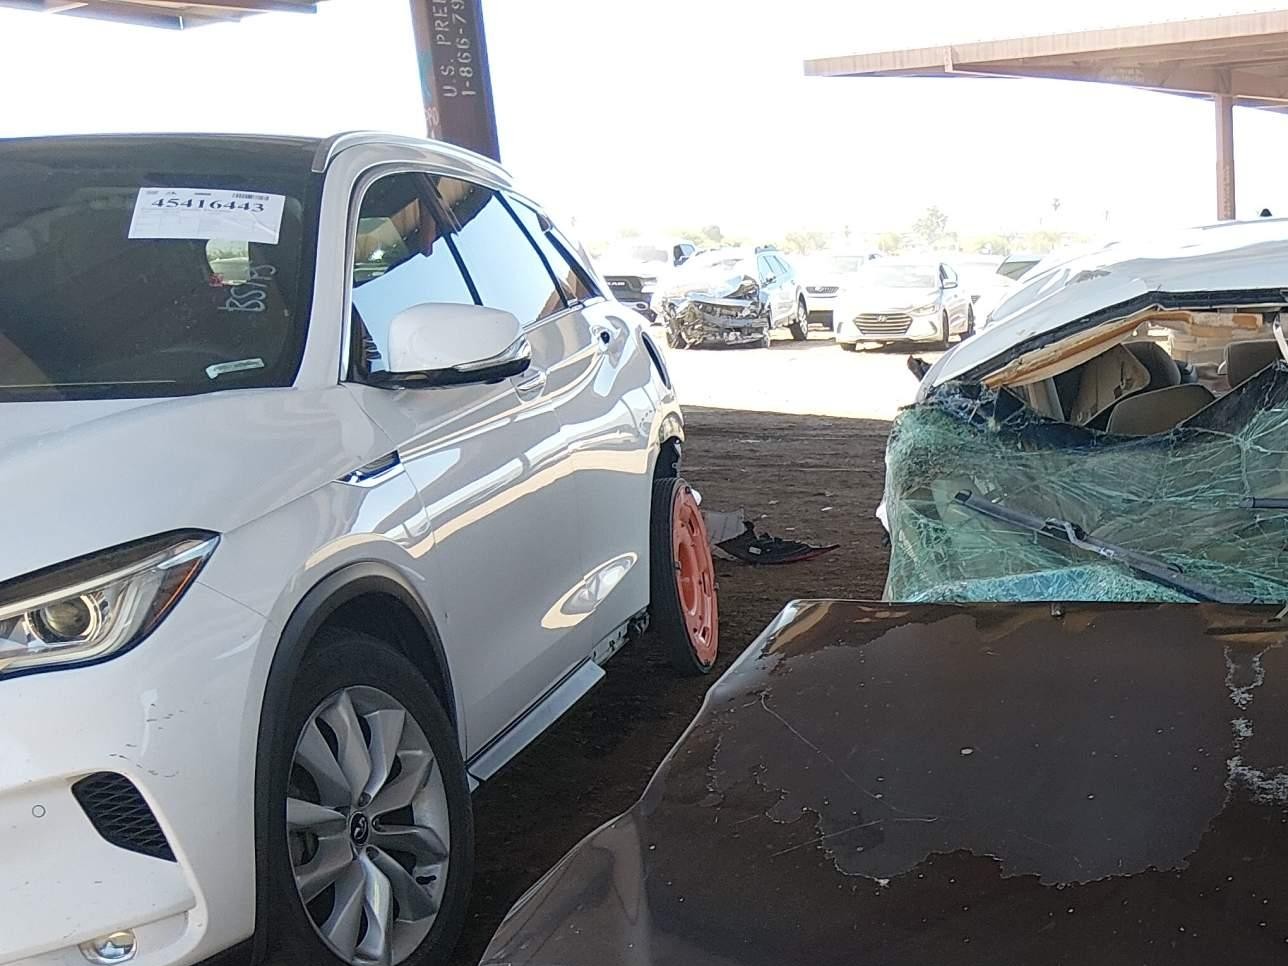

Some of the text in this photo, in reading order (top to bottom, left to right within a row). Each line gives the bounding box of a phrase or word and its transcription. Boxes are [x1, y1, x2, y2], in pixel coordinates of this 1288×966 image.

[432, 0, 458, 97] U.S. PRE
[151, 198, 265, 213] 45416443
